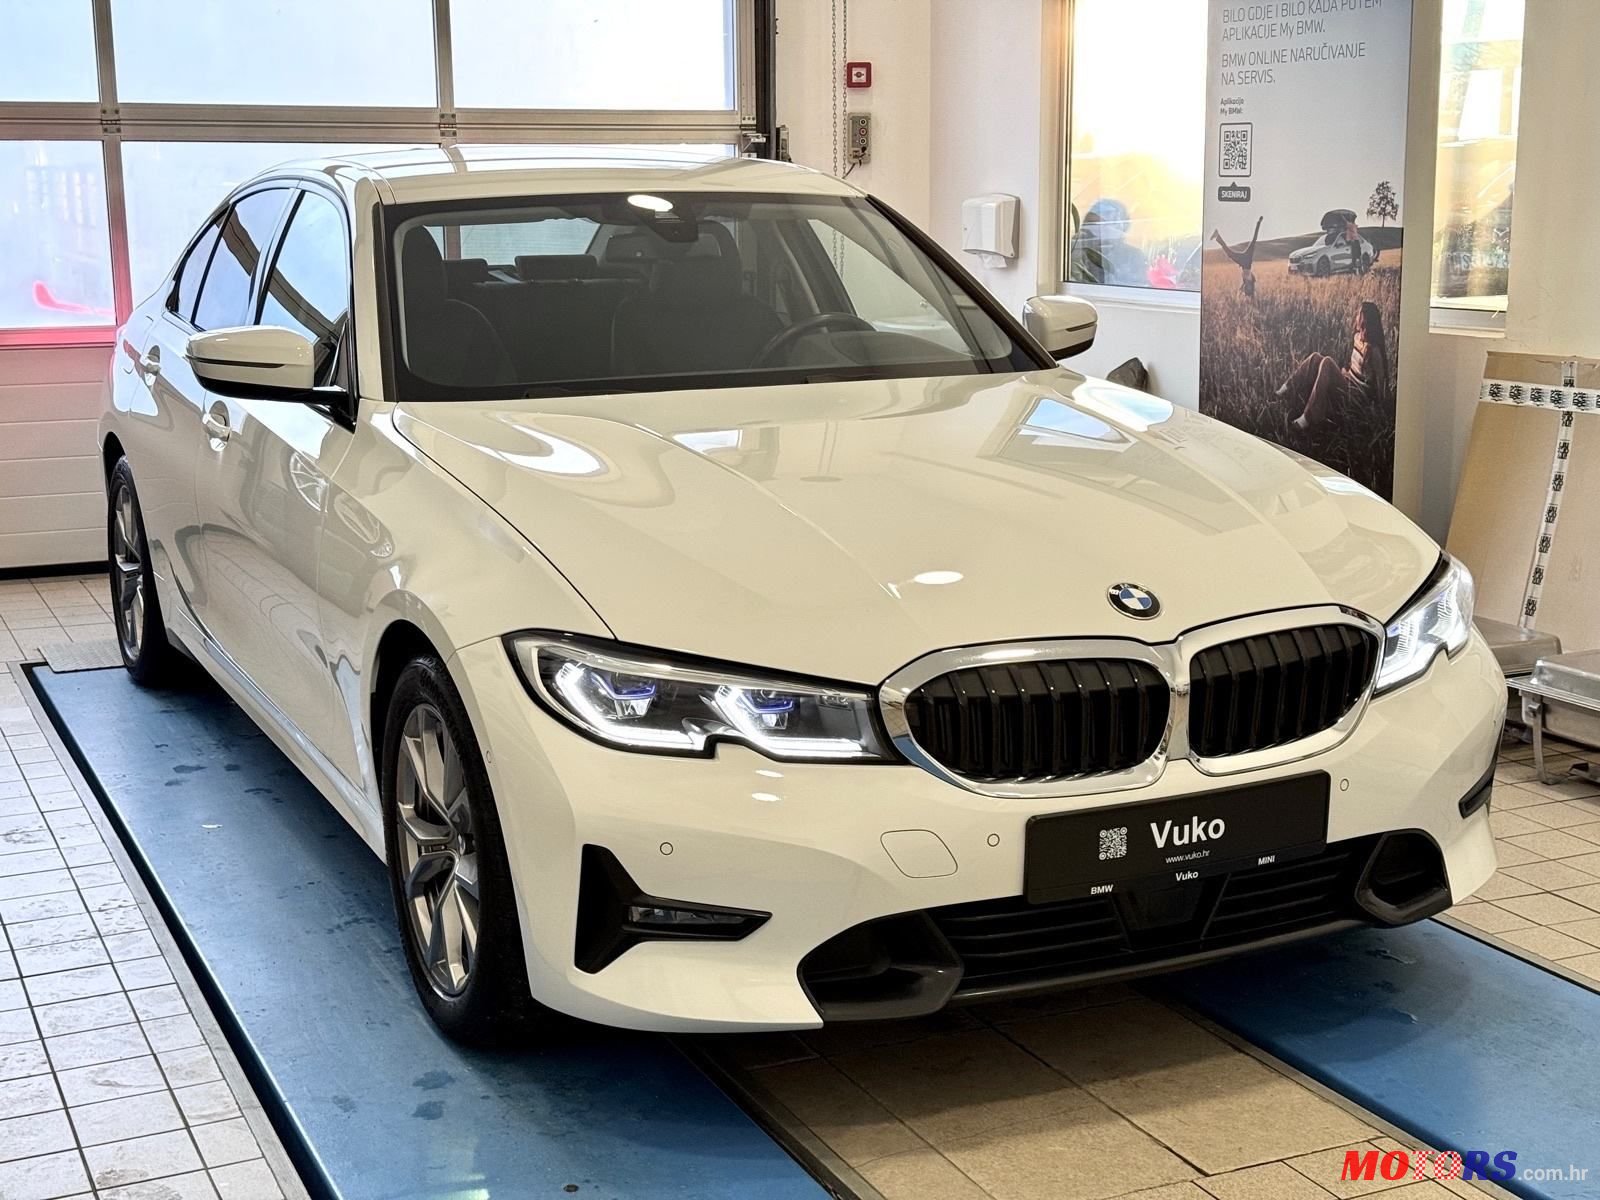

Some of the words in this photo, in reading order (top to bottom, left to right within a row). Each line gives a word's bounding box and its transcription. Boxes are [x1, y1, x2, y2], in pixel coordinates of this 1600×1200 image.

[1223, 8, 1245, 23] BILO
[1248, 5, 1273, 20] GDJE
[1281, 2, 1306, 17] BILO
[1308, 0, 1338, 14] KADA
[1222, 23, 1277, 41] APLIKACIJE
[1279, 22, 1295, 38] My
[1296, 19, 1326, 35] BMW.
[1221, 52, 1246, 68] BMW
[1249, 49, 1287, 66] ONLINE
[1290, 42, 1366, 63] NARUČIVANJE
[1221, 71, 1235, 86] NA
[1237, 69, 1276, 86] SERVIS.
[1221, 190, 1248, 199] SKENIRAJ
[1150, 815, 1226, 849] Vuko
[1165, 850, 1210, 863] www.vuko.hr
[1090, 884, 1114, 895] BMW
[1175, 870, 1199, 882] Vuko
[1257, 854, 1276, 866] MINI
